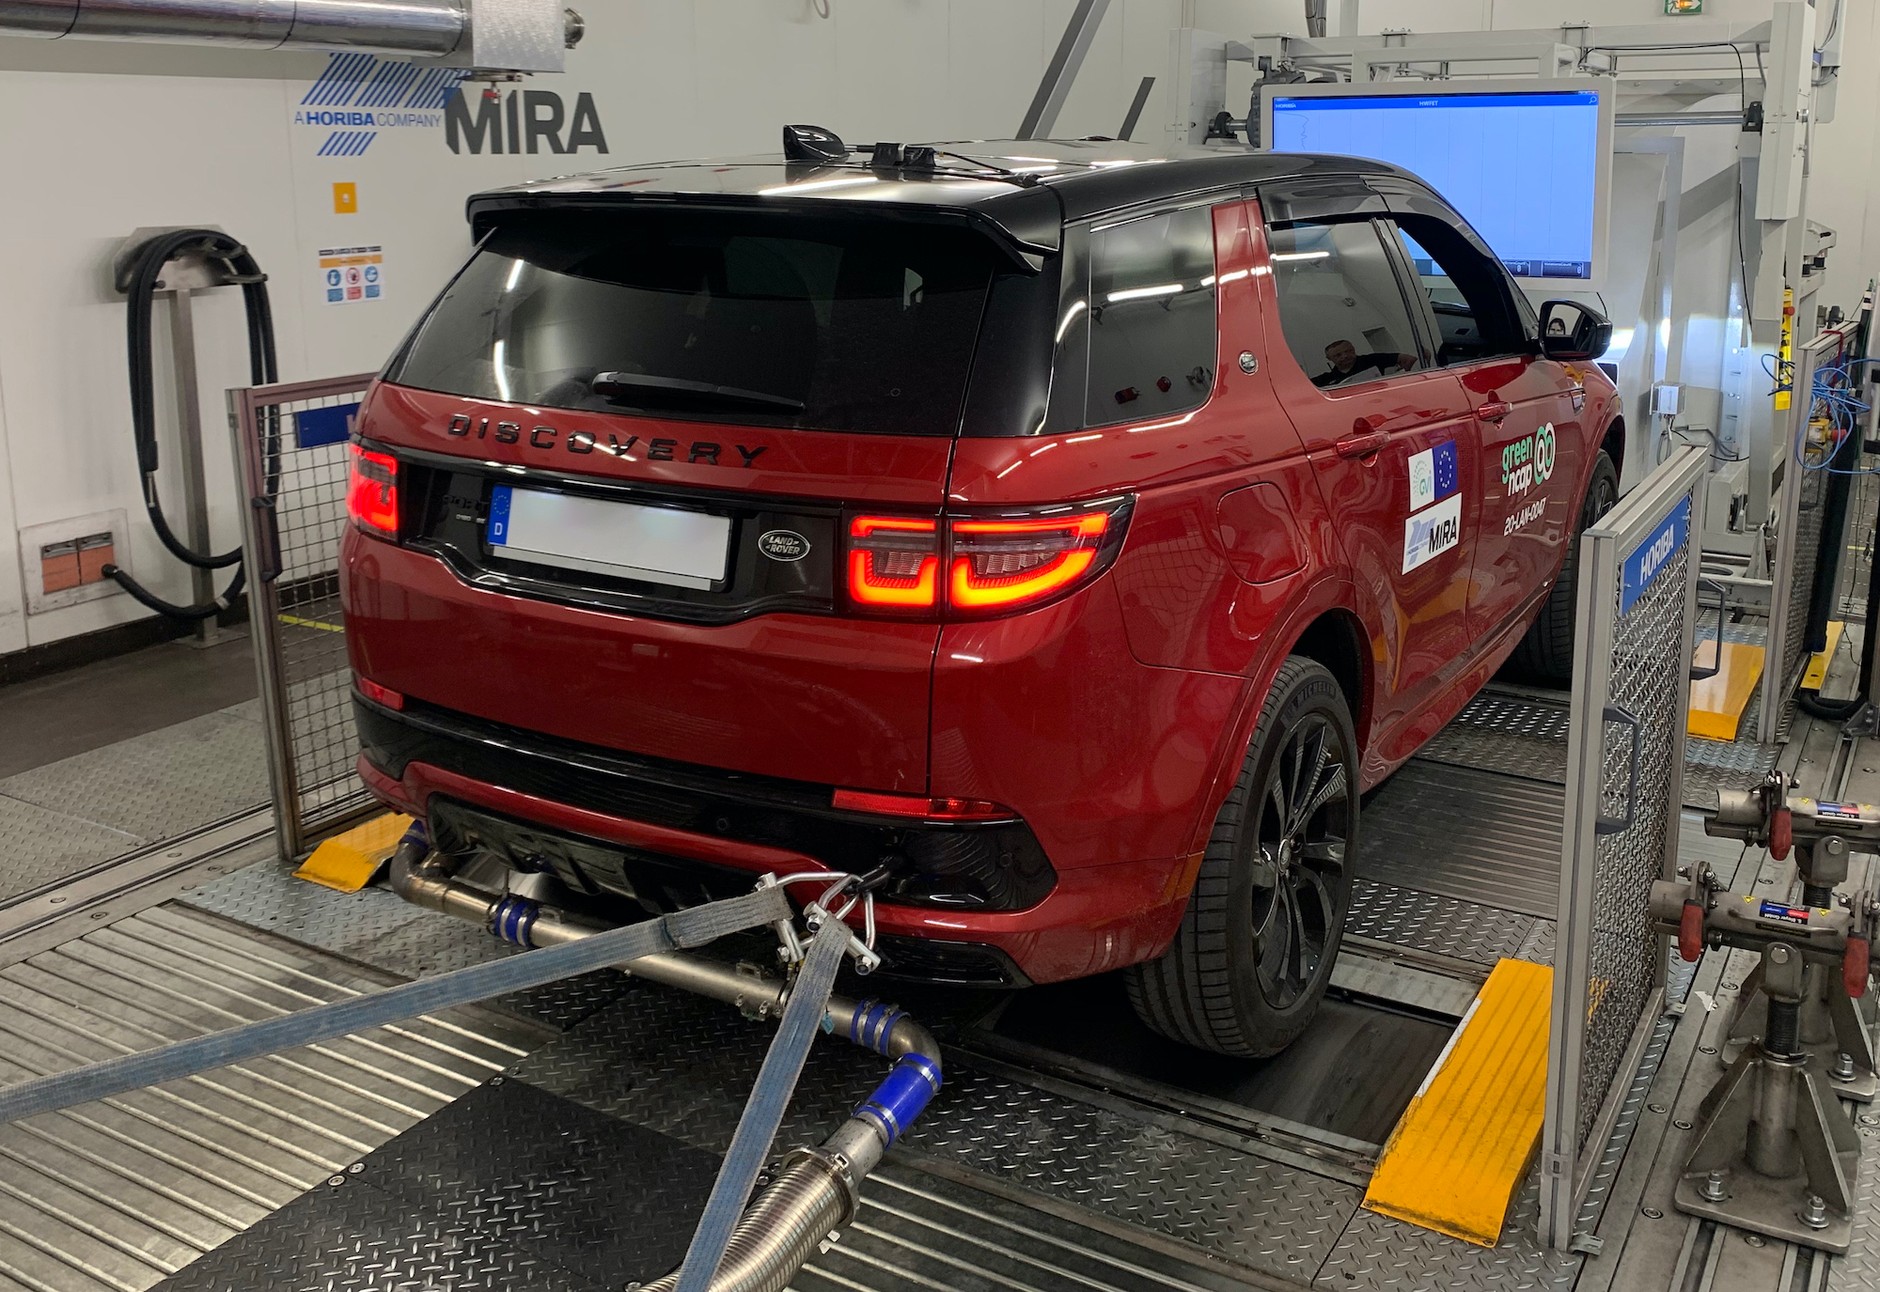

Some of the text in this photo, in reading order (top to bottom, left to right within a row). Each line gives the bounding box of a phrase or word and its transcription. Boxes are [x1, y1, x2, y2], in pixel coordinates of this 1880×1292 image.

[294, 111, 442, 128] A HORIBA COMPANY
[443, 87, 610, 155] MIRA
[448, 413, 767, 468] DISCOVERY
[1502, 436, 1533, 485] green
[1508, 463, 1533, 497] ncap
[493, 522, 503, 536] D
[768, 535, 794, 546] LAND
[1429, 515, 1457, 554] MIRA
[769, 543, 801, 555] ROVER
[1639, 523, 1675, 586] HORIBA
